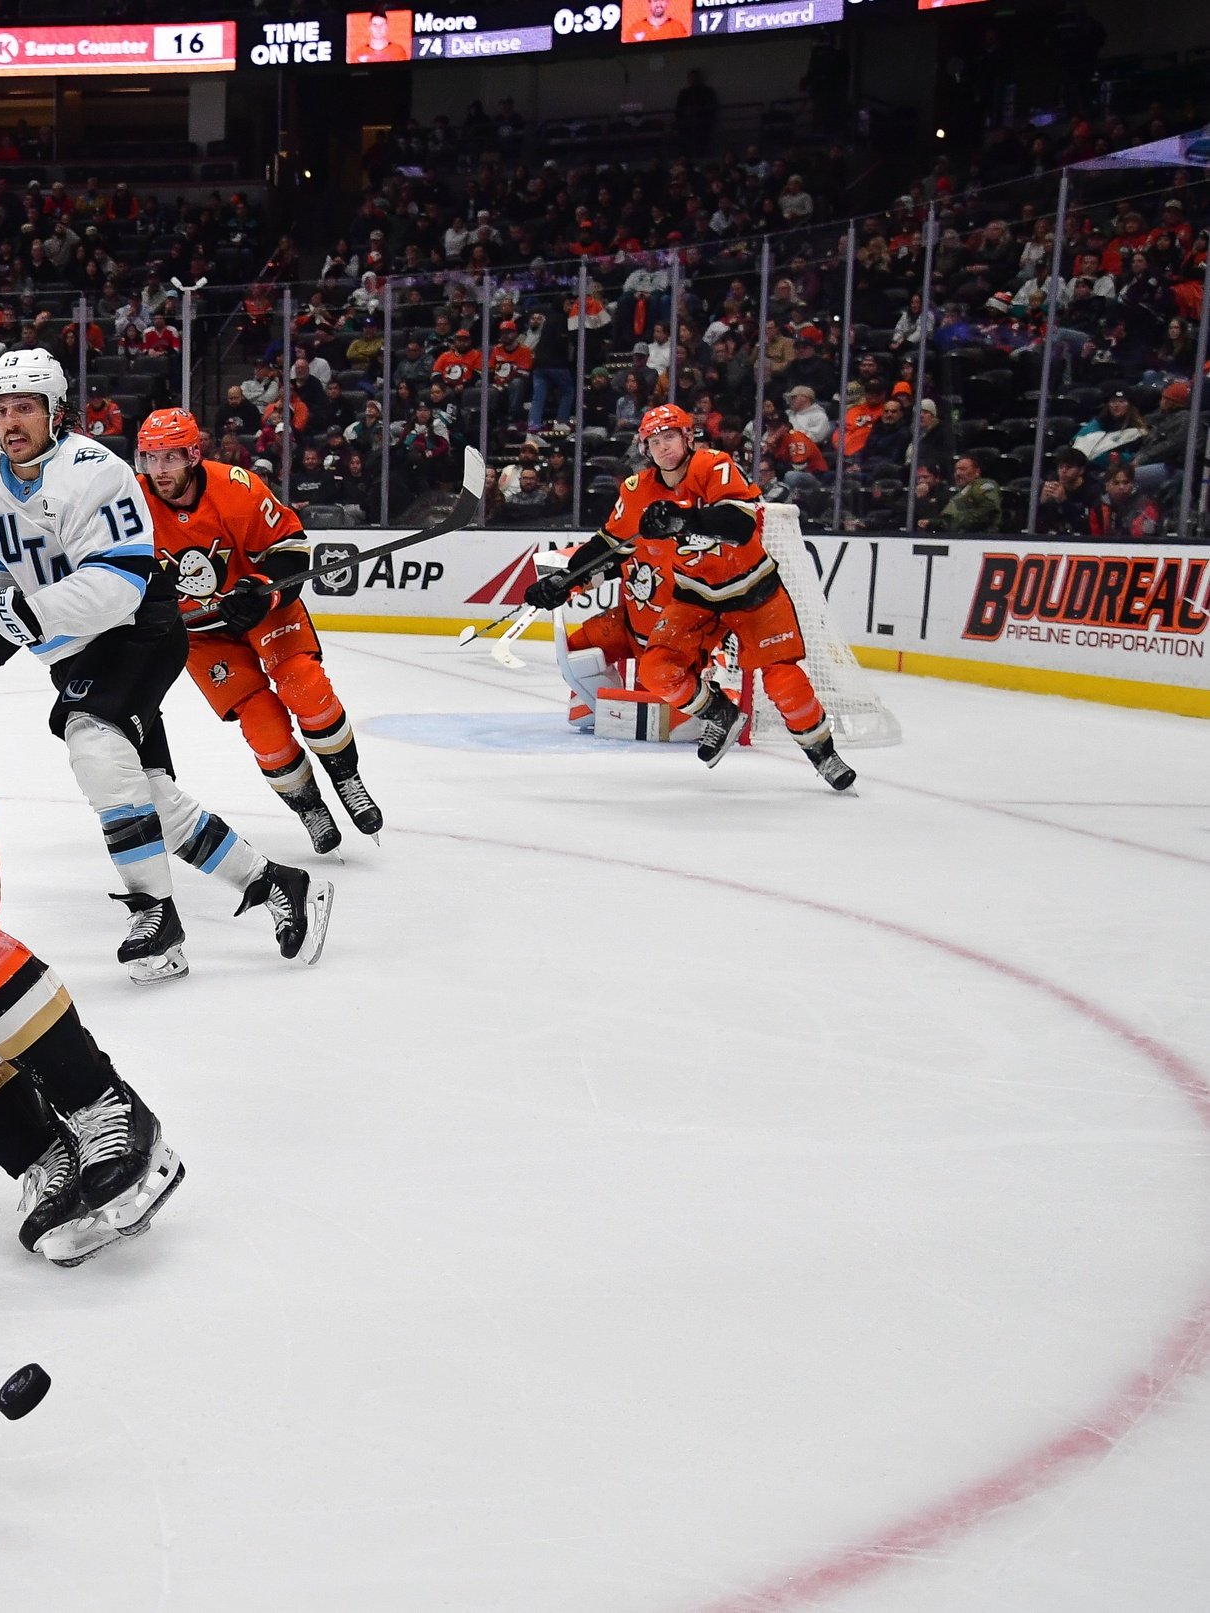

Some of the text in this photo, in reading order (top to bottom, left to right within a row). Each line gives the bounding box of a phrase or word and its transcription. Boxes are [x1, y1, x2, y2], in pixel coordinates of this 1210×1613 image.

[414, 13, 477, 33] Moore
[554, 4, 621, 35] 0:39
[698, 3, 814, 32] 17 Forward
[174, 33, 204, 54] 16
[263, 22, 319, 43] TIME
[25, 41, 75, 57] Saves
[77, 39, 148, 56] Counter
[251, 41, 332, 65] ON ICE
[419, 36, 521, 56] 74 Defense
[4, 356, 19, 367] 13
[99, 496, 144, 543] 13
[962, 552, 1210, 641] BOUDREAU
[261, 622, 301, 647] CCM
[758, 631, 794, 649] CCM
[1006, 624, 1205, 658] PIPELINE CORPORATION
